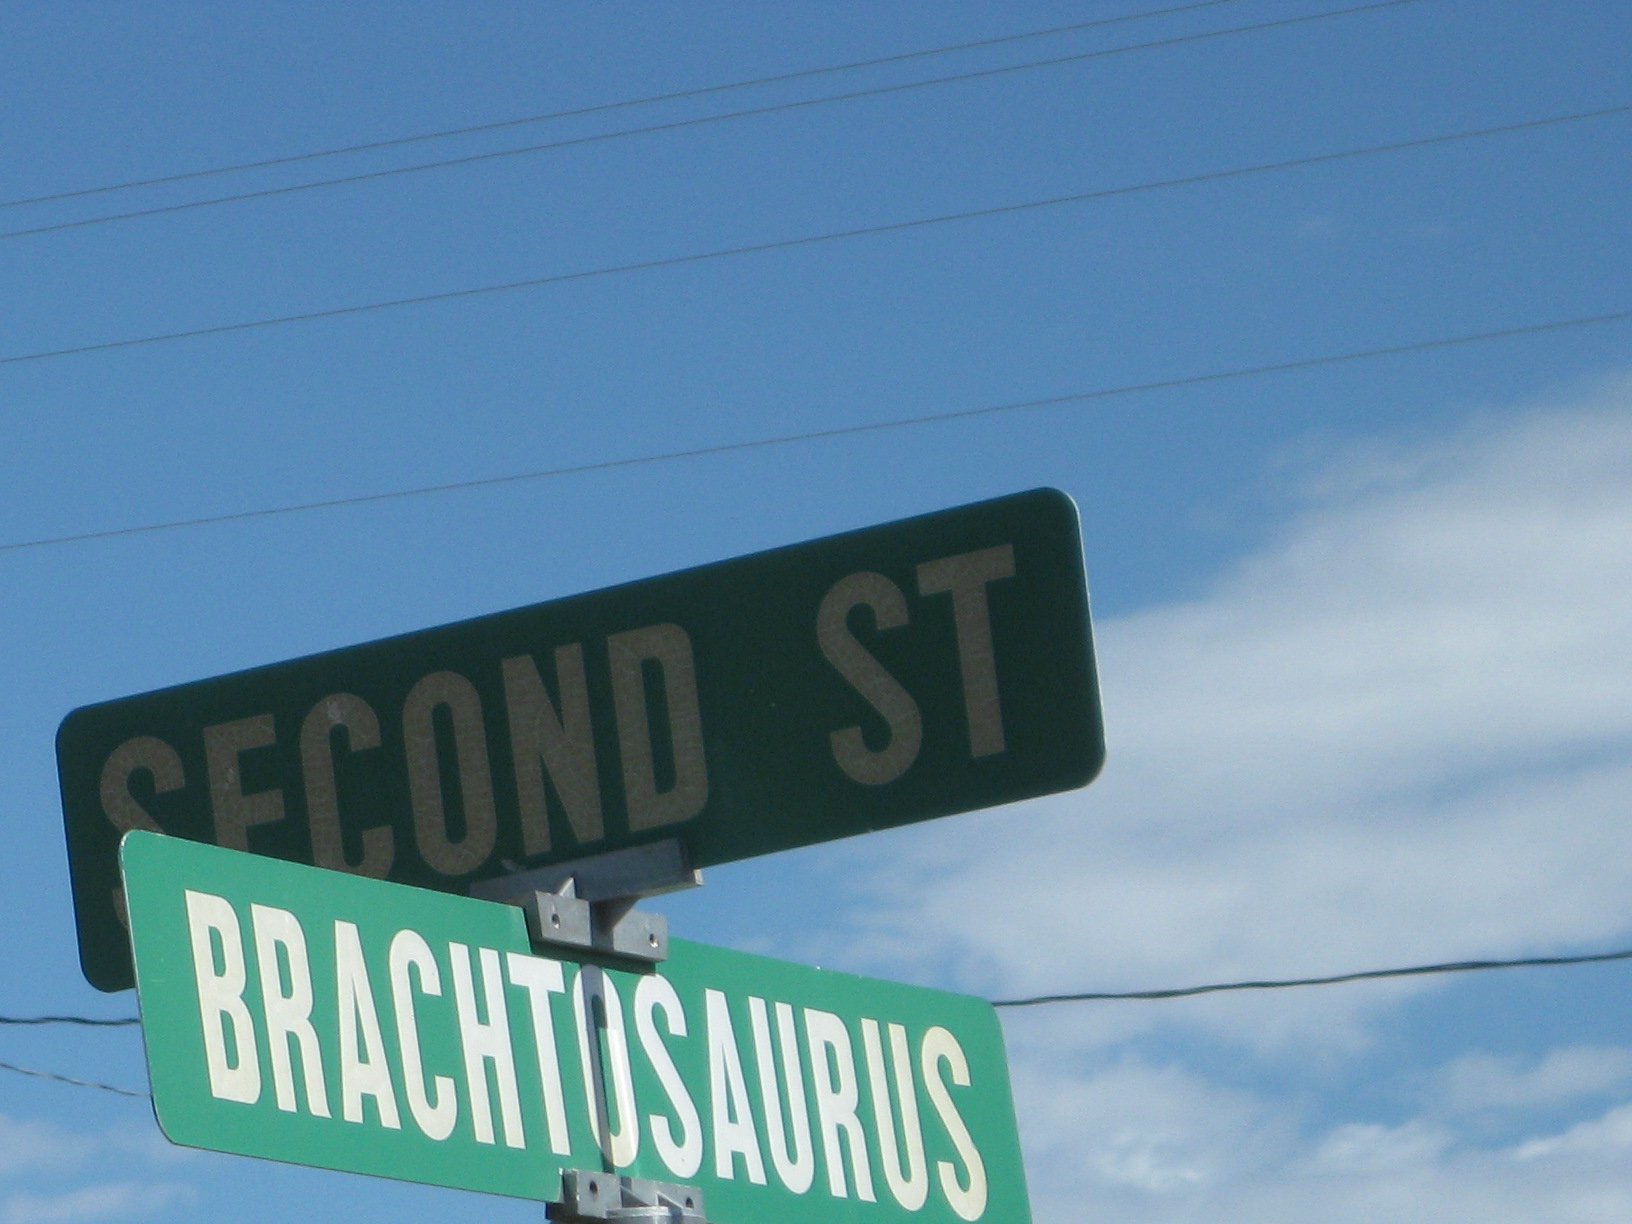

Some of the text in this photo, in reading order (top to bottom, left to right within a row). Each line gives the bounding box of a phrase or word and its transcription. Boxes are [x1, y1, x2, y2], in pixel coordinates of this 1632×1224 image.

[100, 543, 1017, 930] SECOND ST
[184, 889, 989, 1223] BRACHTOSAURUS
